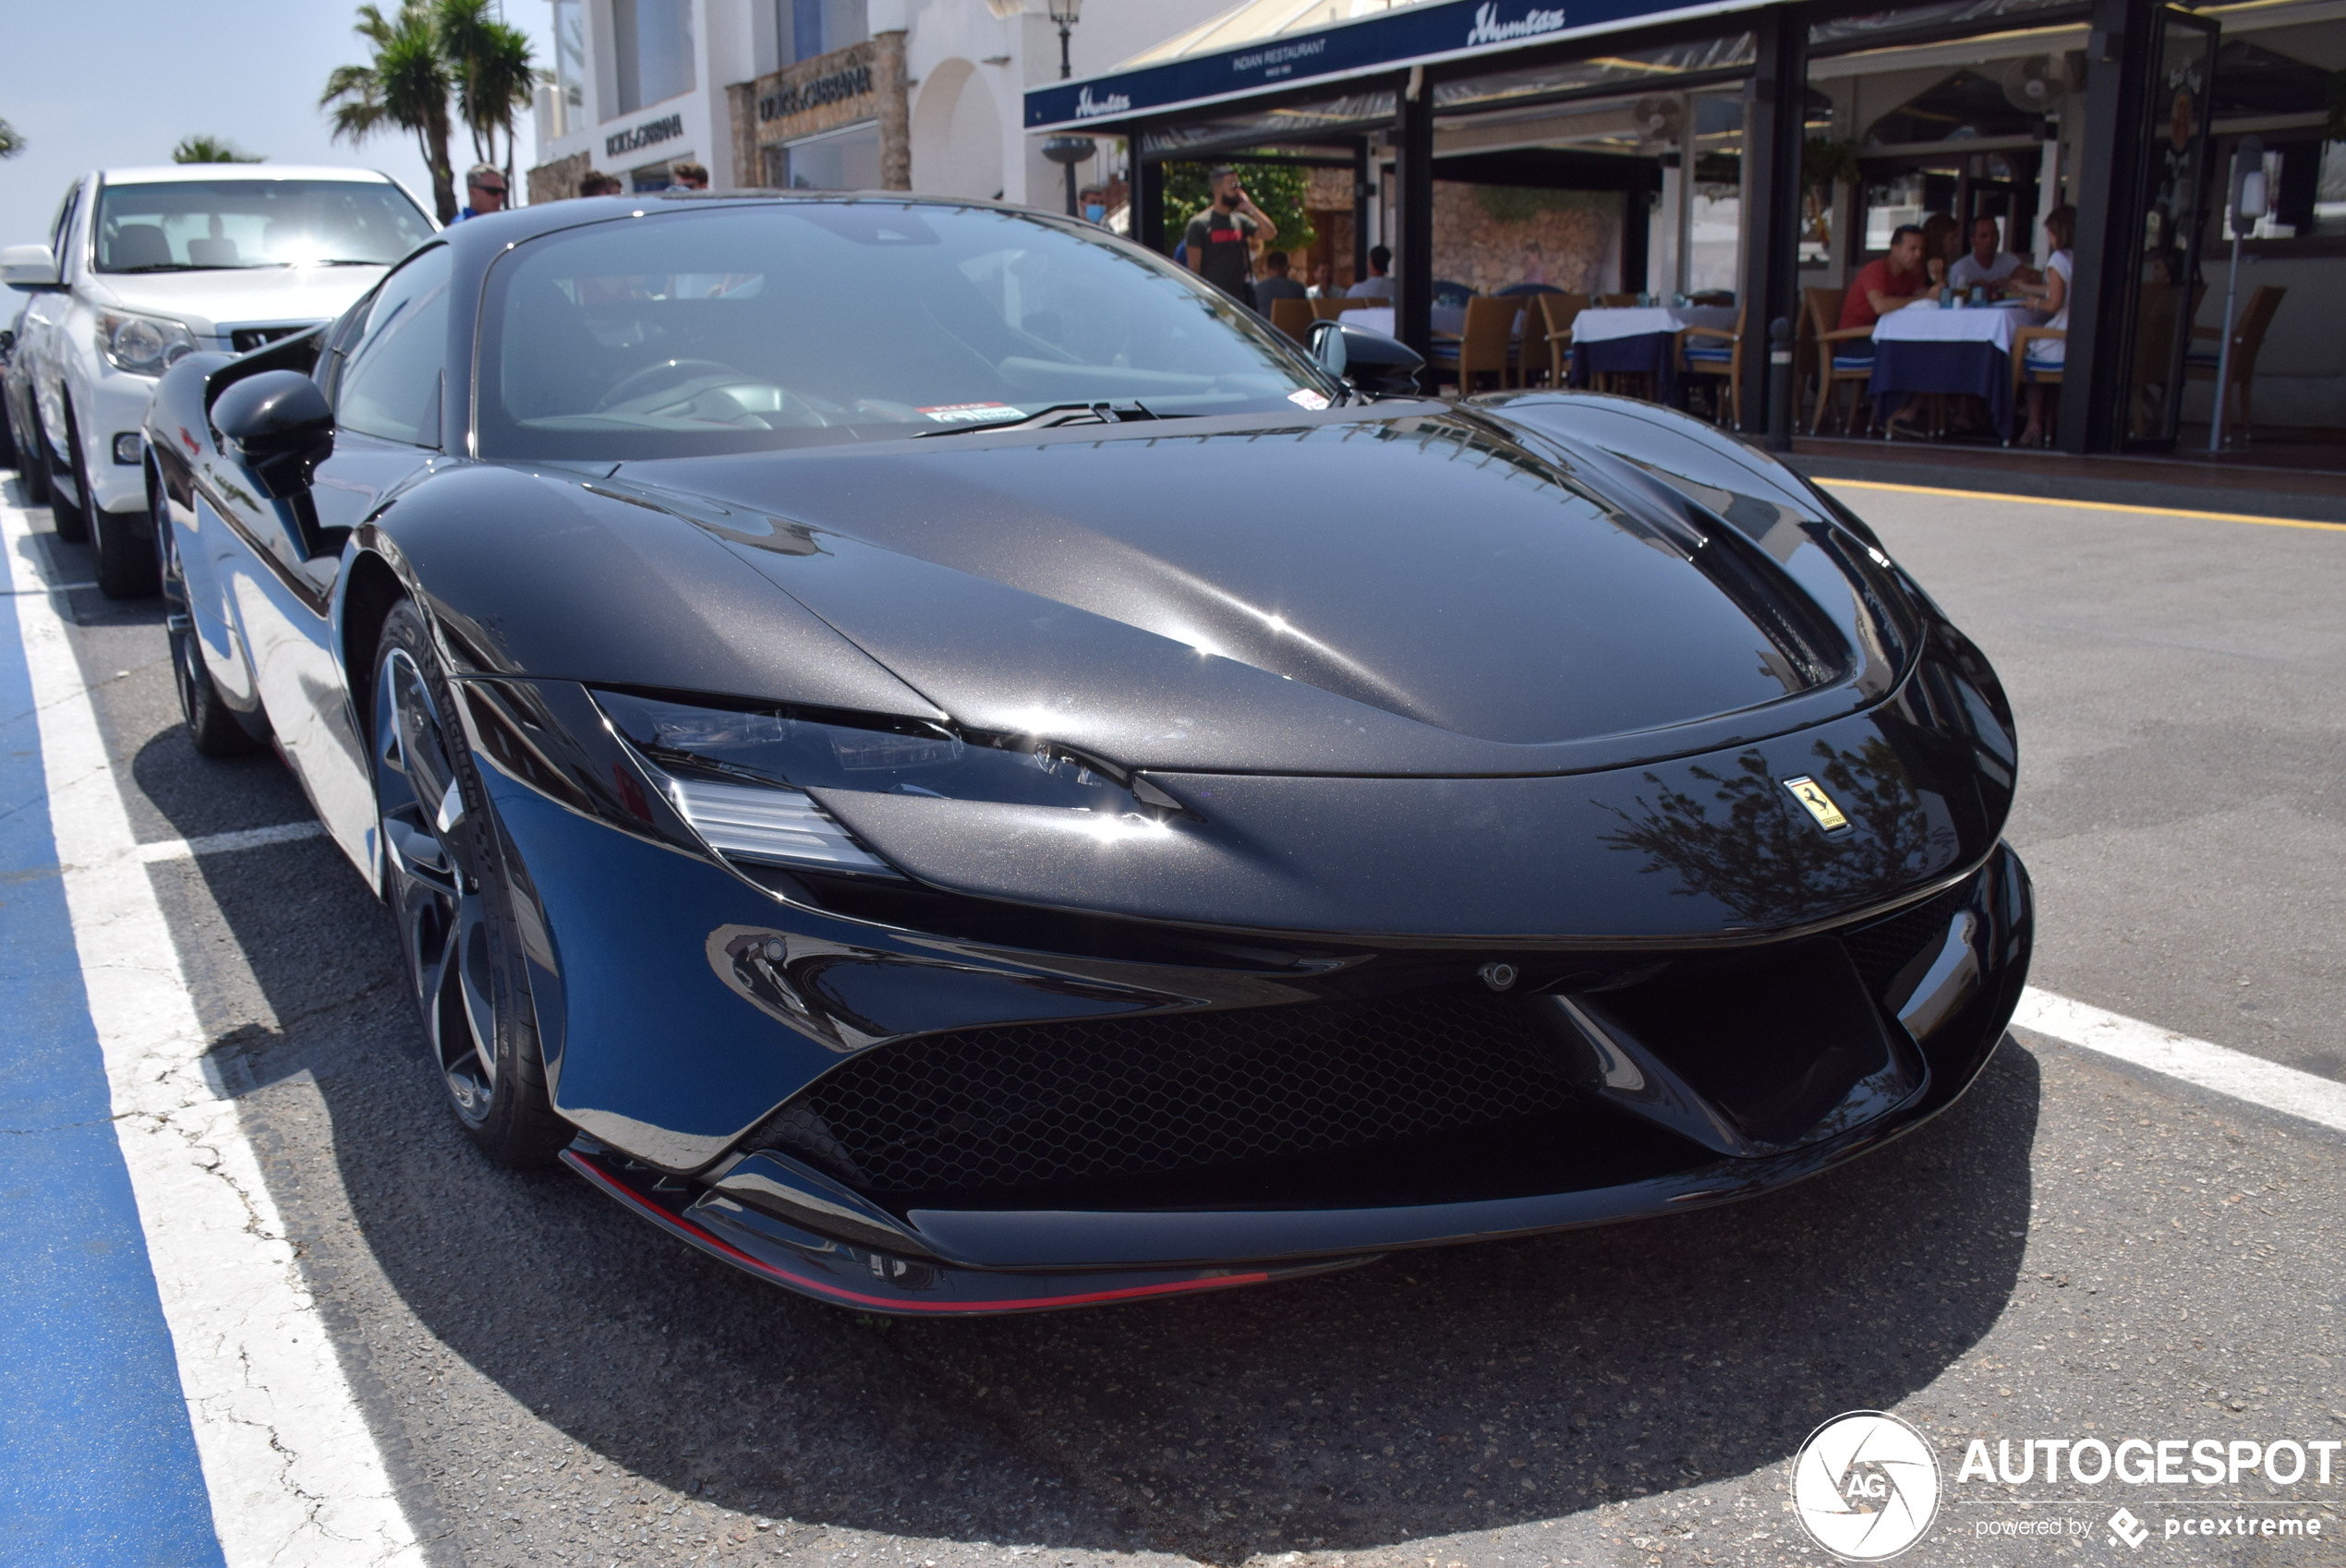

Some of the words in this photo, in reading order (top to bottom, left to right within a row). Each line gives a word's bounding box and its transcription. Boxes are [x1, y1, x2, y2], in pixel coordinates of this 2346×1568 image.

[1232, 53, 1263, 71] INDIAN
[1264, 39, 1326, 65] RESTAURANT
[441, 694, 478, 808] MICHELIN
